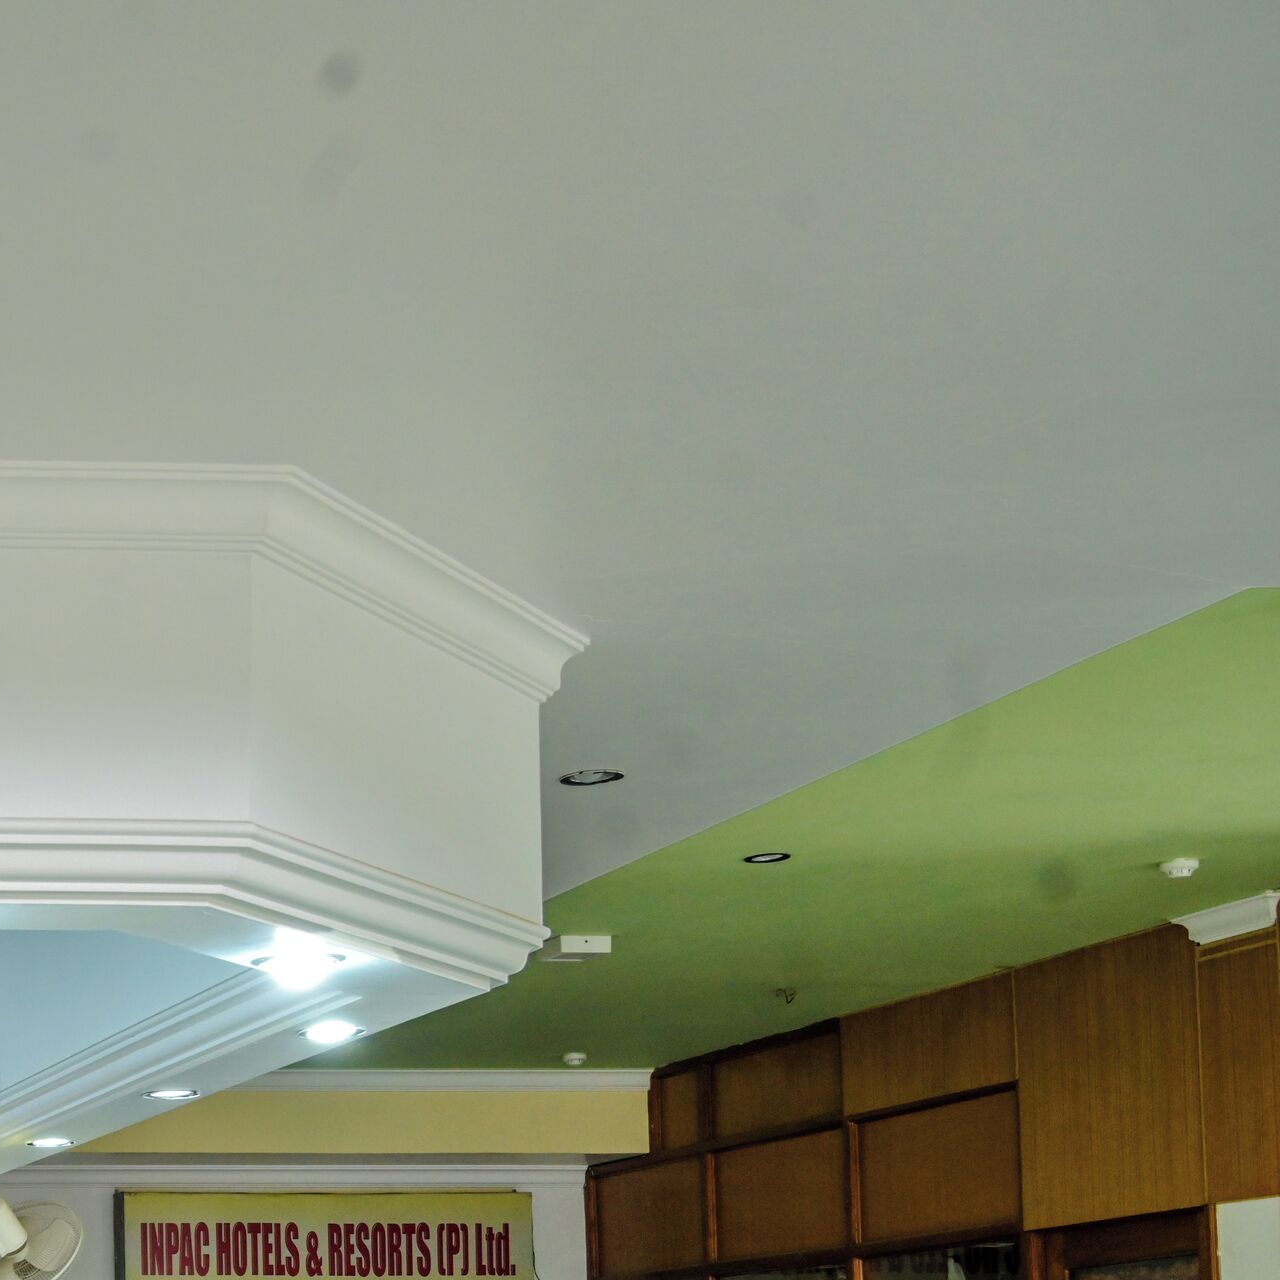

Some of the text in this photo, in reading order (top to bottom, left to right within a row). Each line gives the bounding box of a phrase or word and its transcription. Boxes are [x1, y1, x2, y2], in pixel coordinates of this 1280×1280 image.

[140, 1221, 210, 1277] INPAC
[215, 1221, 300, 1277] HOTELS
[306, 1231, 323, 1277] &
[327, 1222, 432, 1277] RESORTS
[475, 1223, 516, 1277] Ltd.
